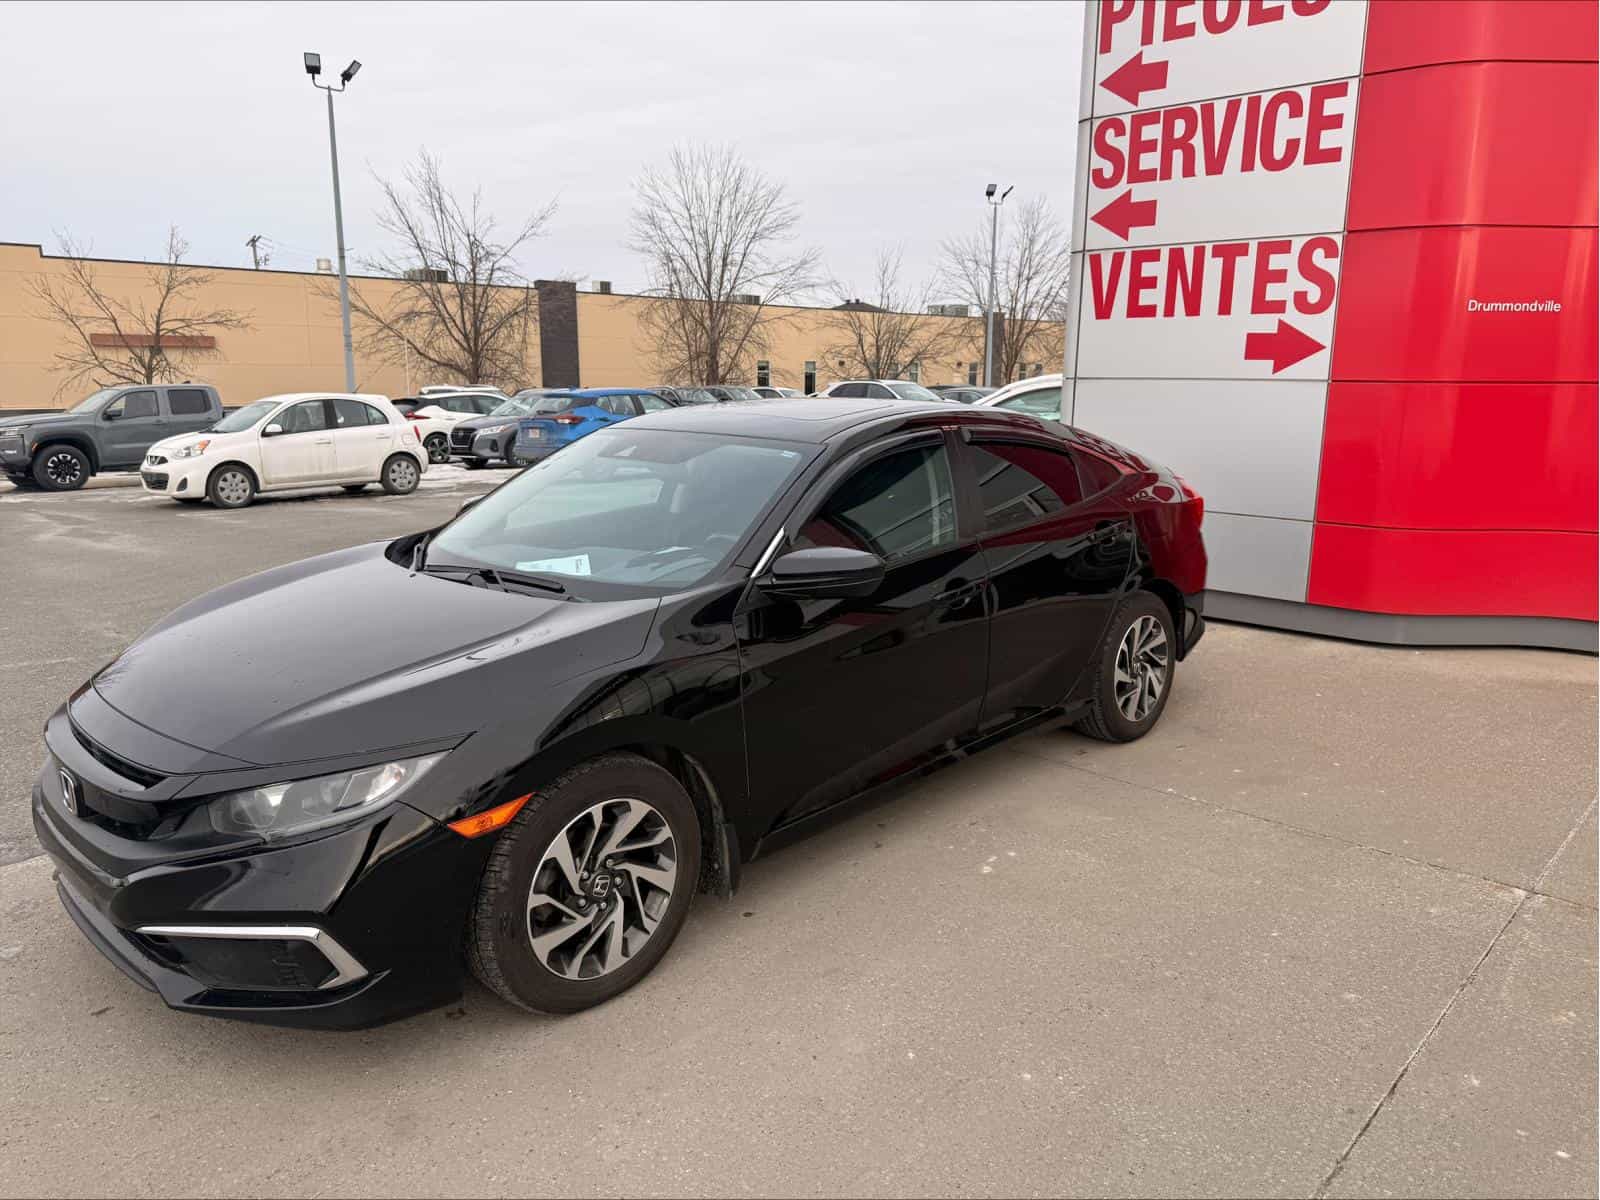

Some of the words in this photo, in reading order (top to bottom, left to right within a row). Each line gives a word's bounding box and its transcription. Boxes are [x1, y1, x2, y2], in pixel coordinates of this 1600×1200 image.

[1091, 81, 1349, 190] SERVICE
[1089, 236, 1338, 320] VENTES
[1467, 299, 1562, 312] Drummondville
